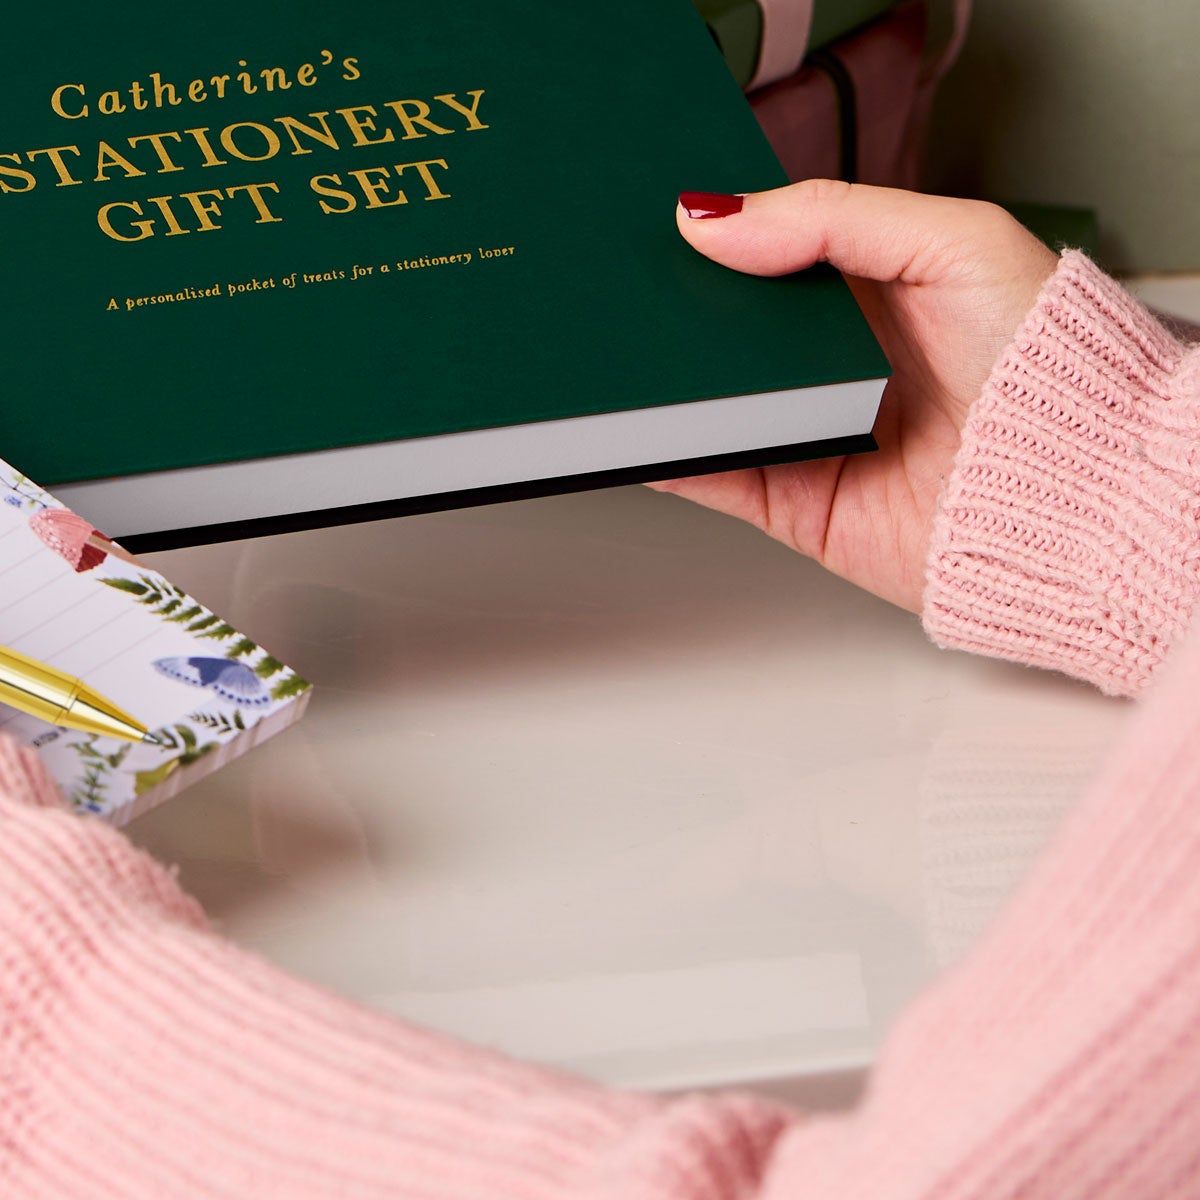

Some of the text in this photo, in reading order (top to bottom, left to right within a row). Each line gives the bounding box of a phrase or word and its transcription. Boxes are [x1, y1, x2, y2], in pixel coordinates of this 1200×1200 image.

[51, 50, 361, 119] Catherine's
[97, 159, 451, 242] GIFT SET
[106, 245, 516, 311] A personalised pocket of treats for a stationery lover
